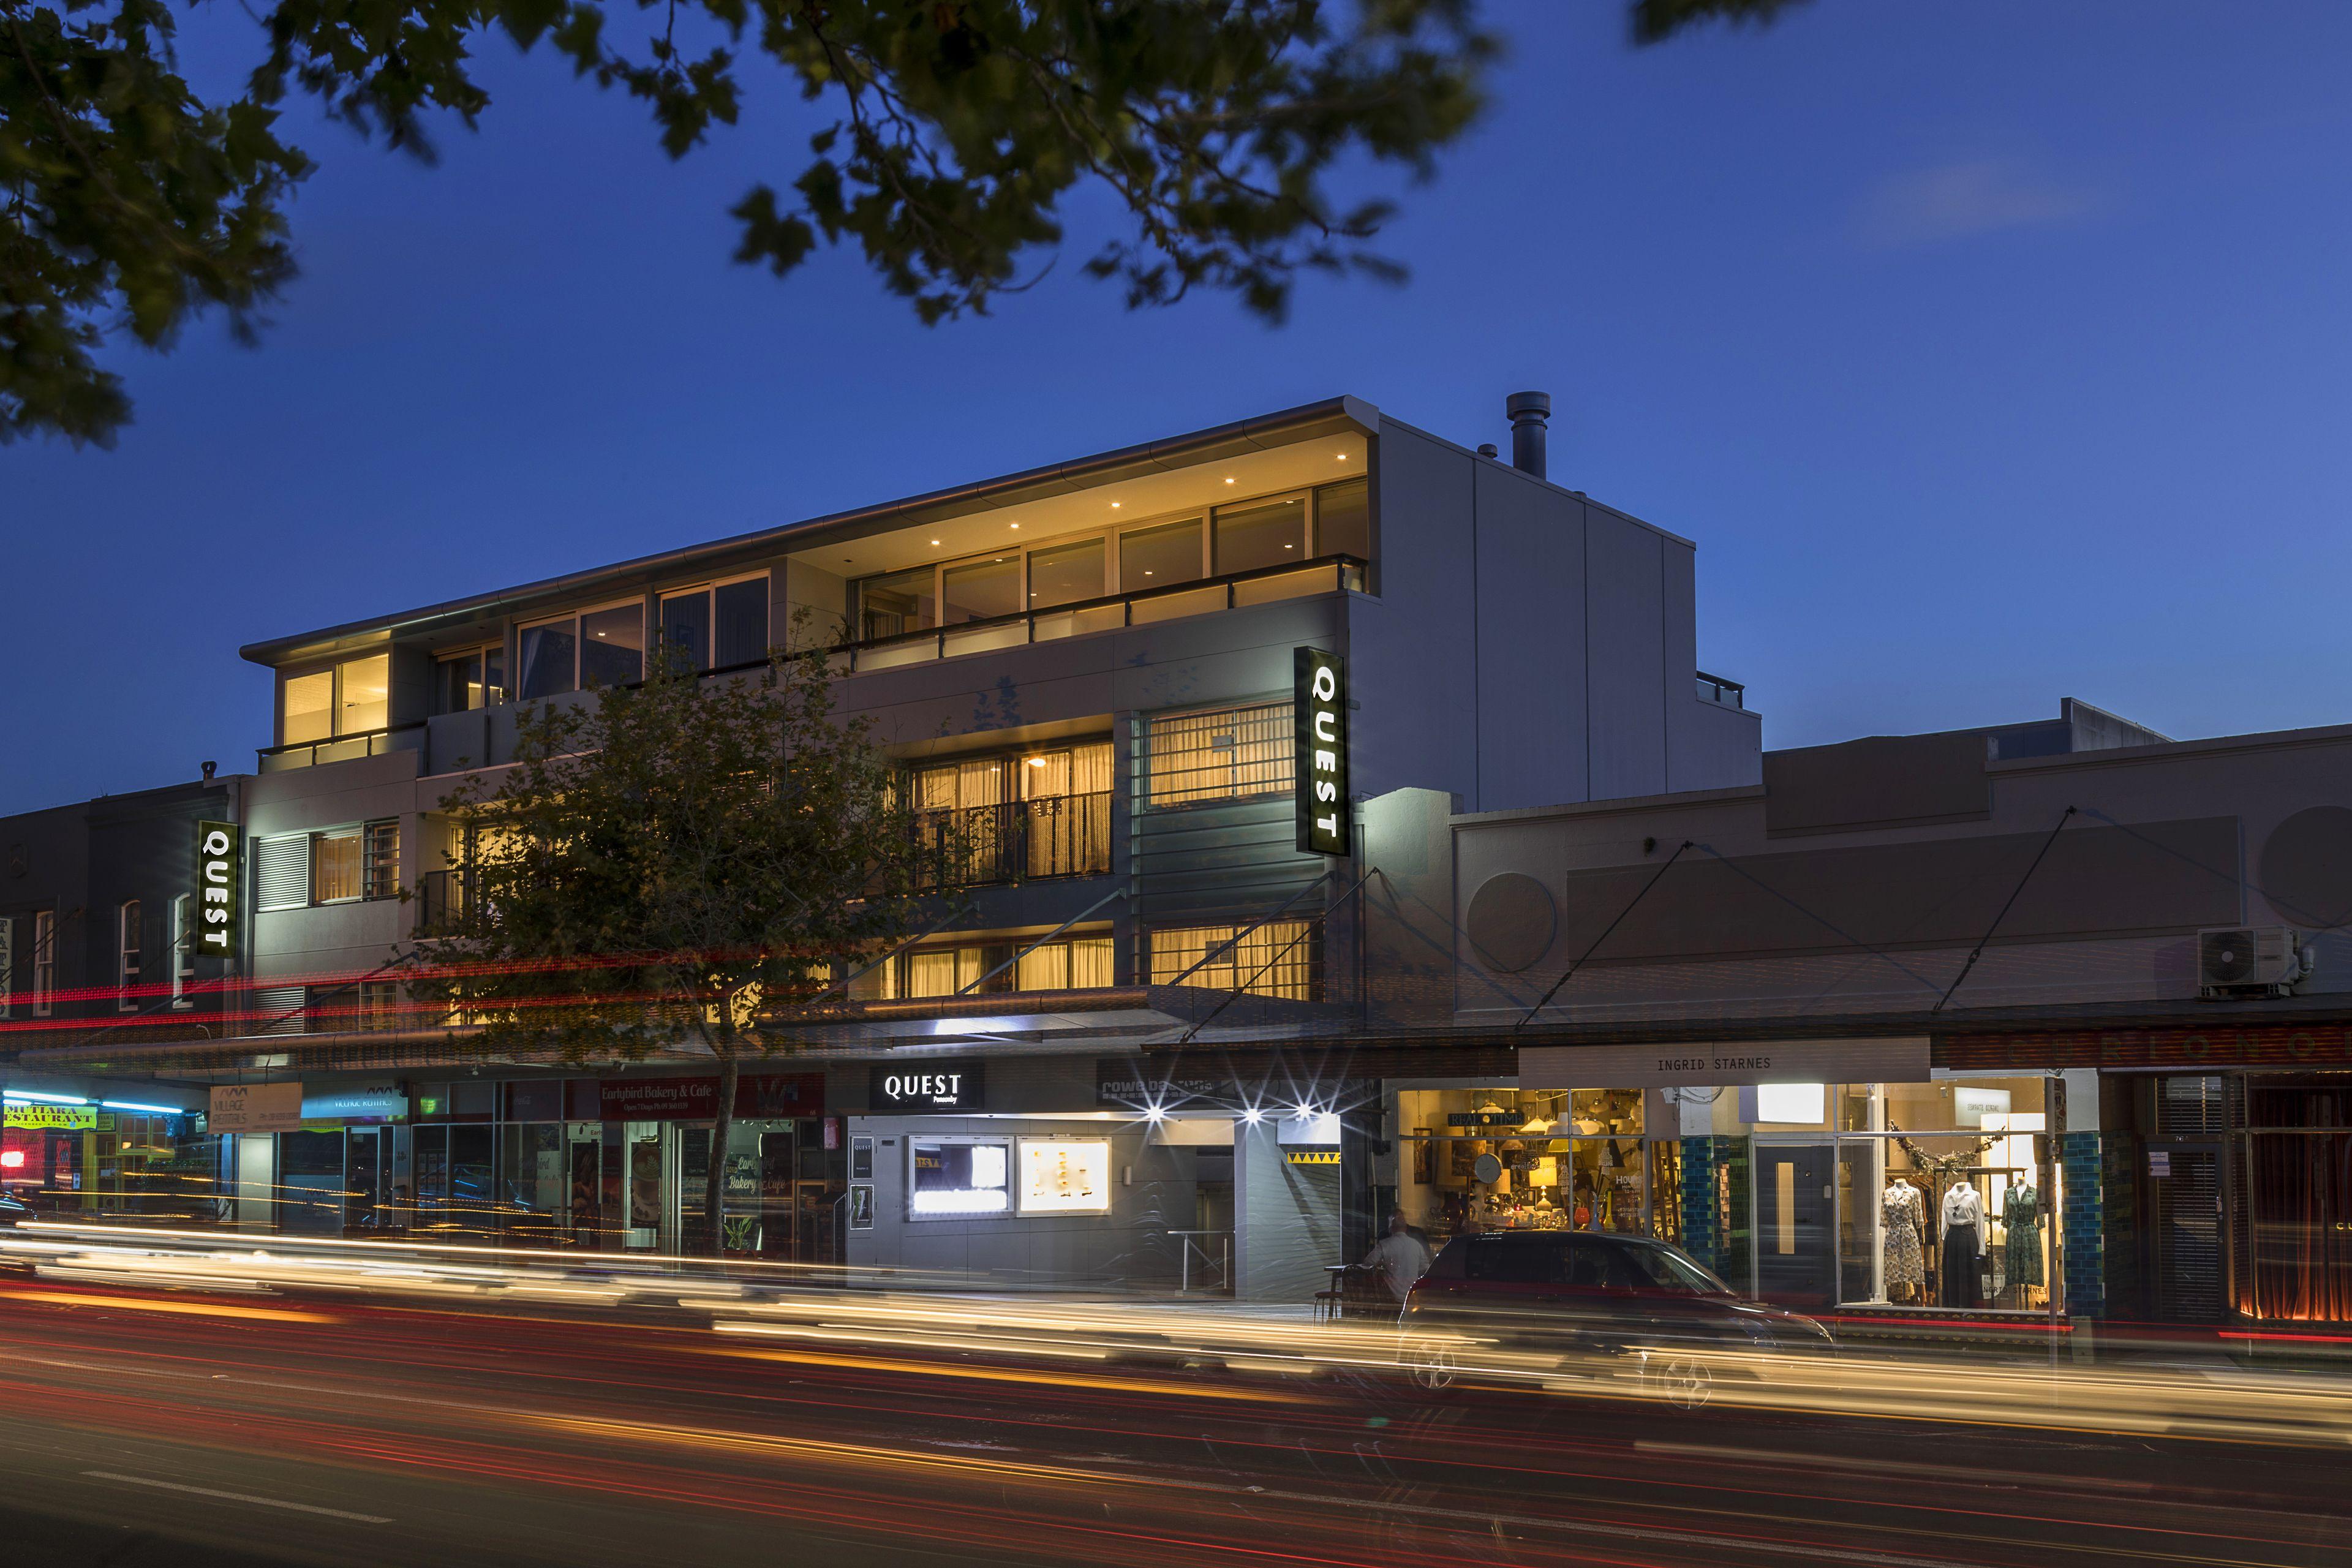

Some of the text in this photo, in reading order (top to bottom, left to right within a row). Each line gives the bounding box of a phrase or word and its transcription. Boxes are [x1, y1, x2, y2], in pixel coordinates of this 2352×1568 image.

[1313, 666, 1336, 837] QUEST
[203, 831, 228, 947] QUEST
[1658, 1057, 1770, 1071] INGRID STARNES
[602, 1084, 712, 1101] Earlybird Bakery & Cafe
[884, 1074, 961, 1100] QUEST
[1102, 1080, 1145, 1092] rowe
[214, 1099, 245, 1111] VILLAGE
[334, 1098, 361, 1107] VILLAGE
[933, 1095, 957, 1104] Ponsonby
[213, 1114, 247, 1125] RENTALS
[1452, 1114, 1523, 1125] REAL TIME
[729, 1175, 755, 1194] Bakery
